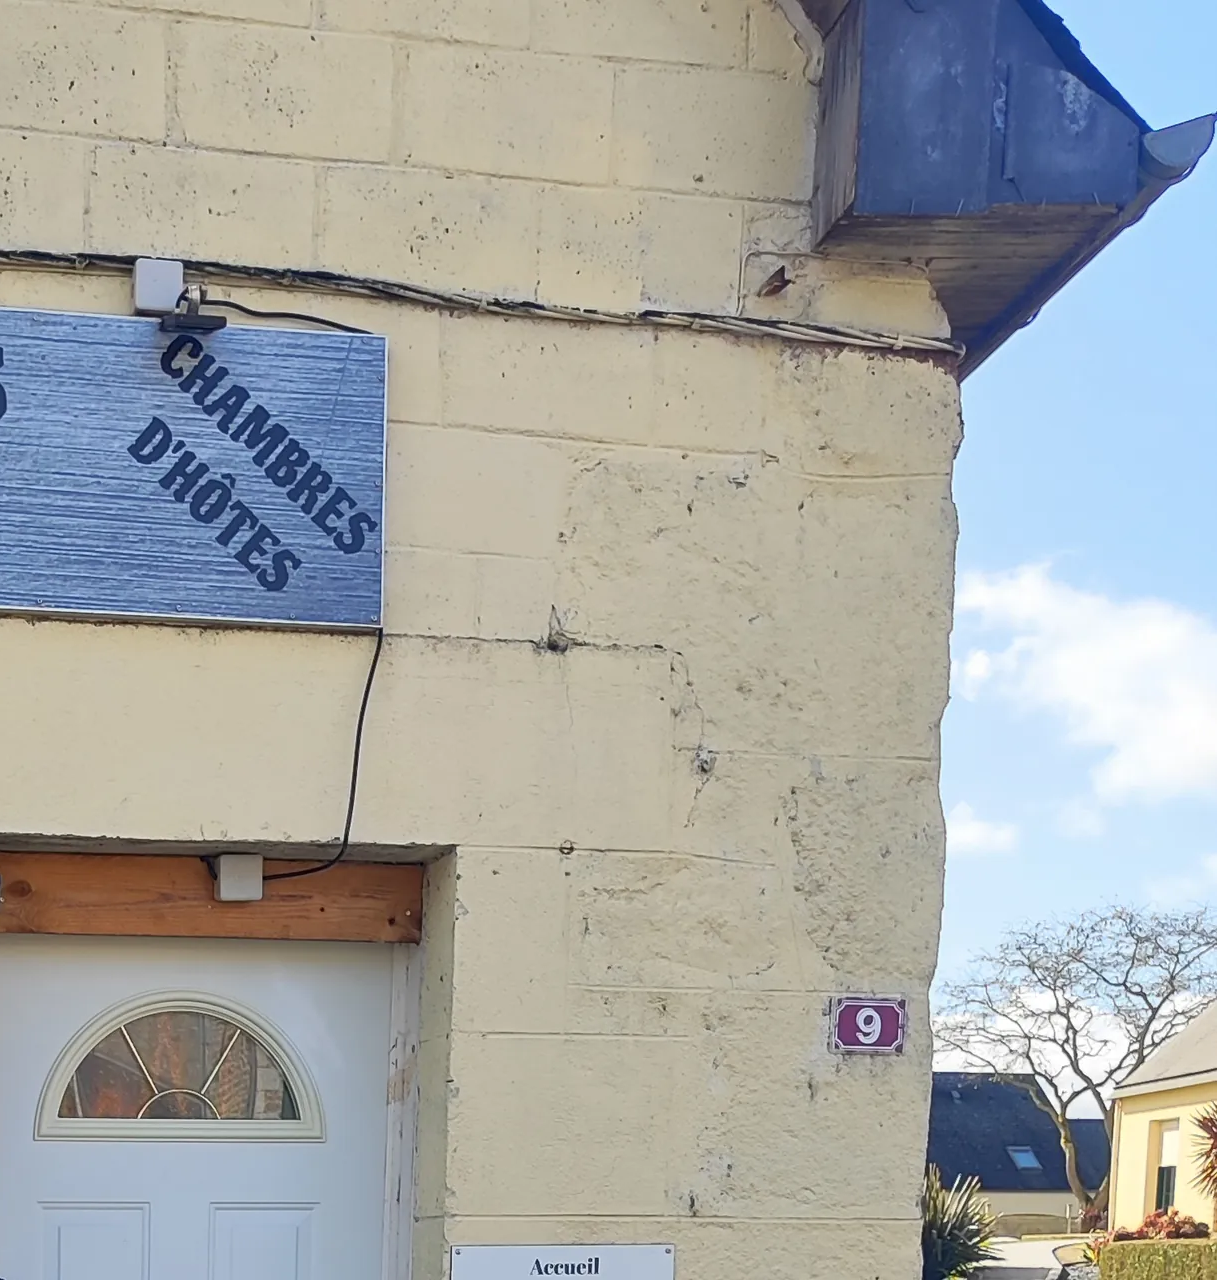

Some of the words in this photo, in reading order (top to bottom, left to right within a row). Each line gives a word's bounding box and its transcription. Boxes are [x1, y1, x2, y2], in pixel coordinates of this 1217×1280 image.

[160, 334, 378, 554] CHAMBRES
[127, 416, 302, 591] D'HÔTES
[856, 1007, 882, 1044] 9
[530, 1257, 599, 1275] Accueil
